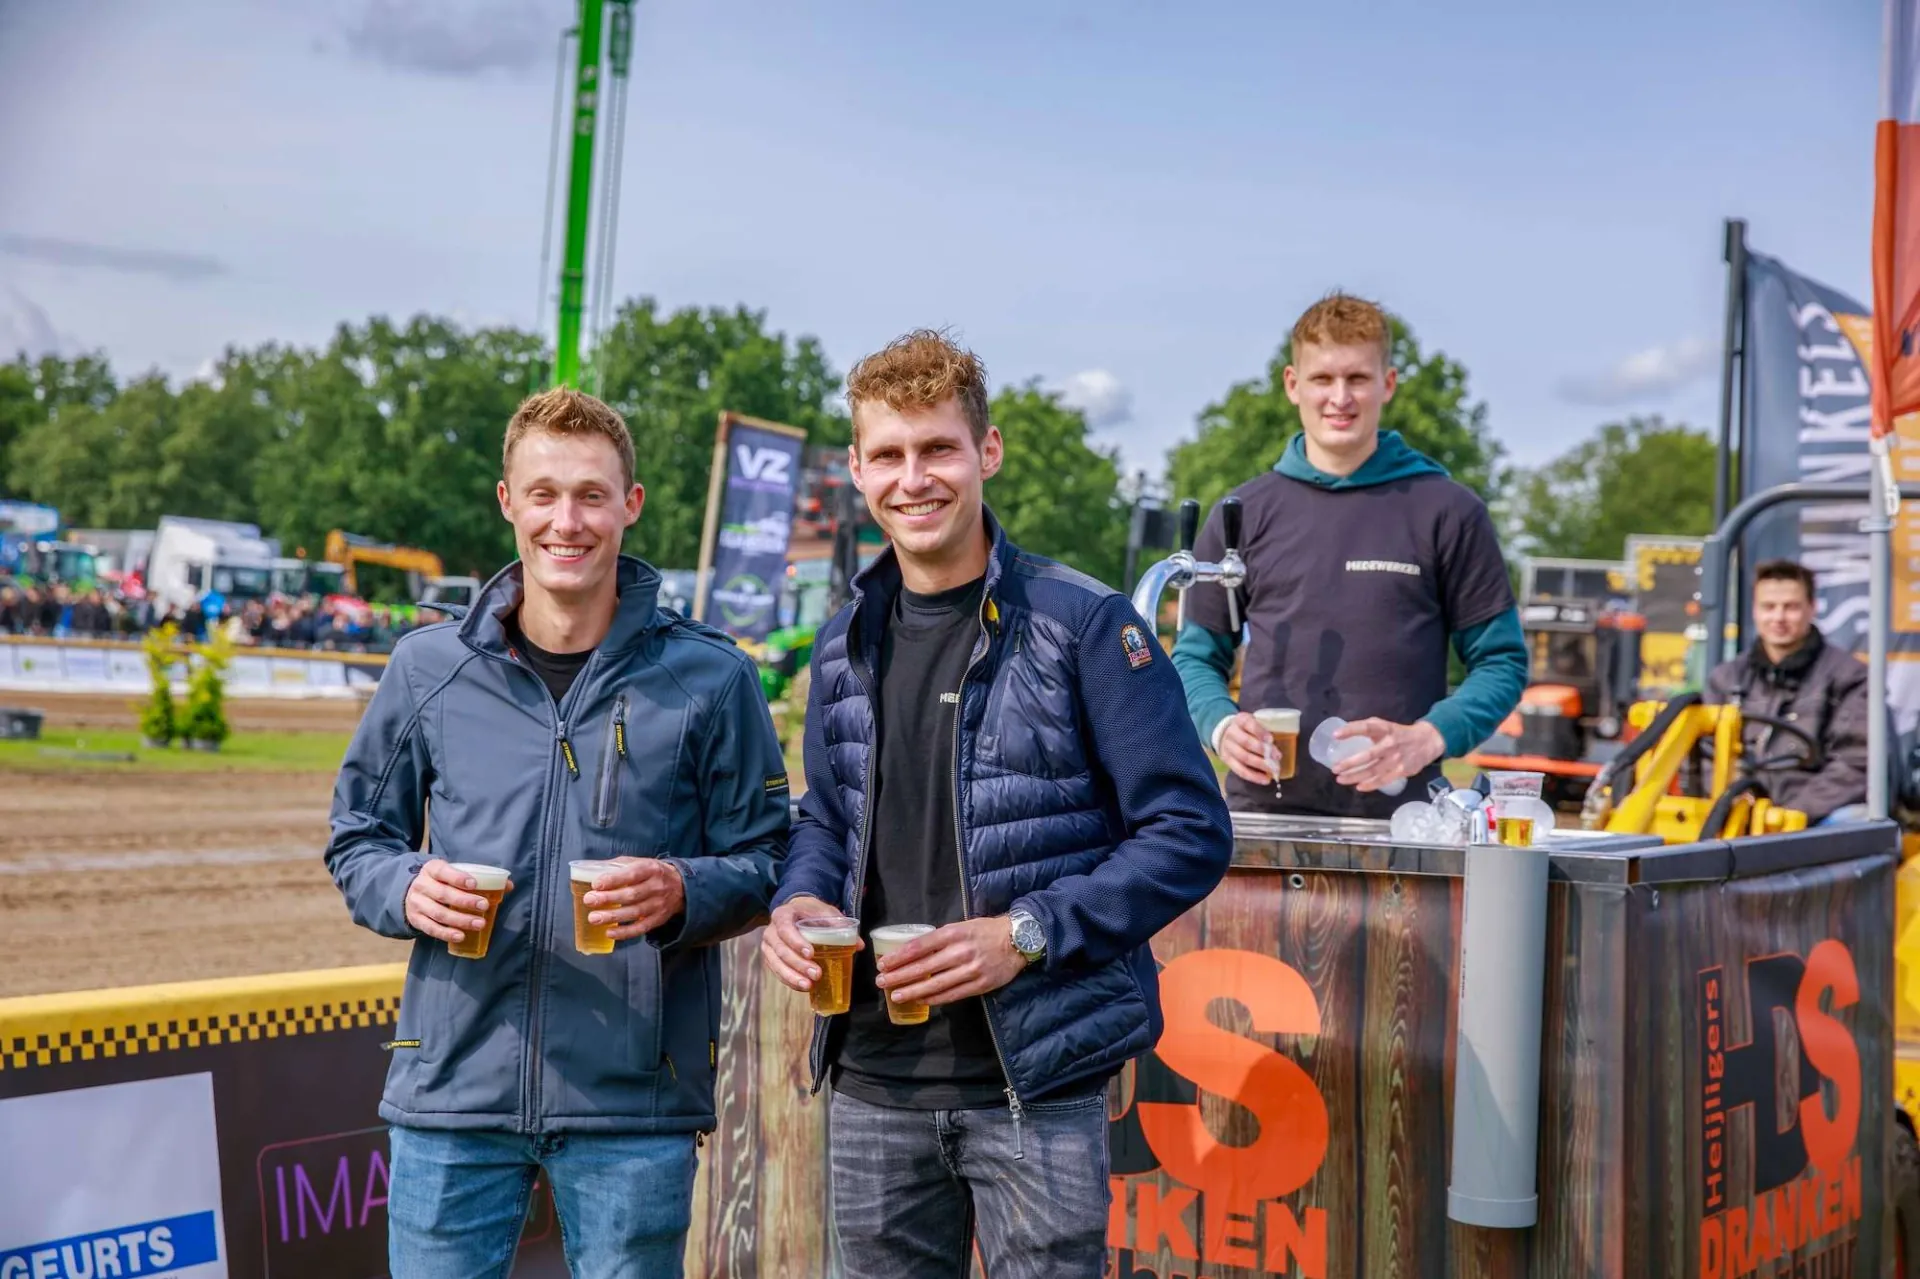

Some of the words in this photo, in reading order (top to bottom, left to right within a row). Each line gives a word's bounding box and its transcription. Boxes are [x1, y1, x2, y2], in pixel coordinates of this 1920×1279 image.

[736, 444, 792, 485] VZ
[1794, 302, 1871, 635] SWINKELS
[939, 692, 961, 703] MED
[1704, 977, 1725, 1207] Heijligers
[275, 1149, 389, 1243] IMA
[1700, 1155, 1862, 1279] DRANKEN
[1, 1226, 175, 1279] GEURTS
